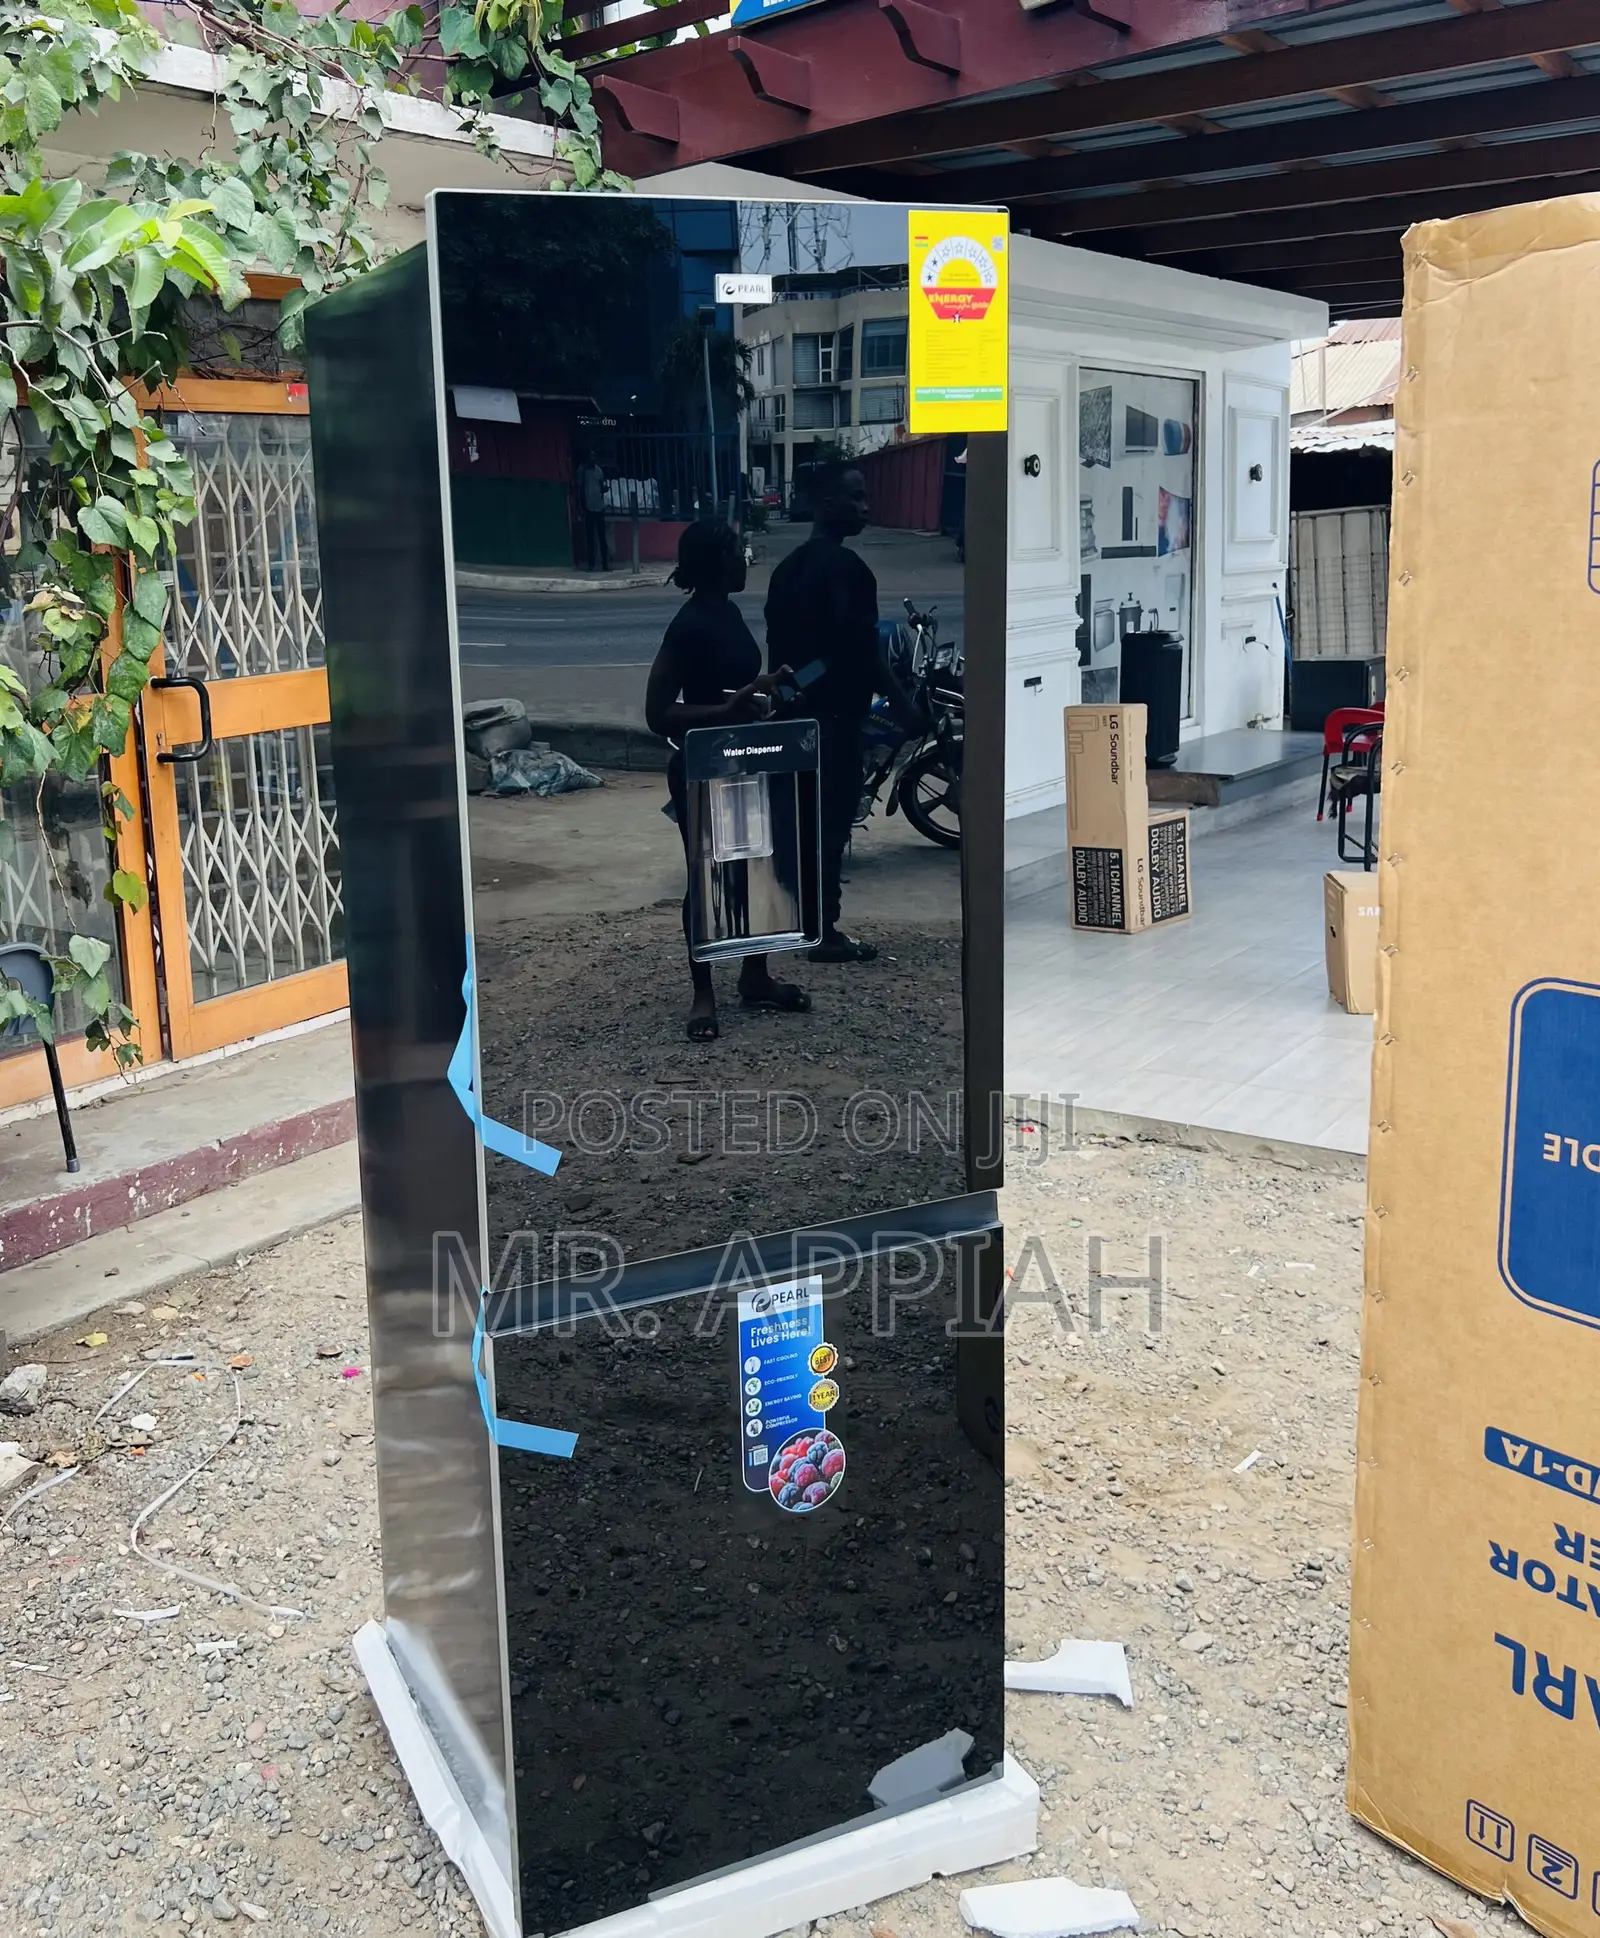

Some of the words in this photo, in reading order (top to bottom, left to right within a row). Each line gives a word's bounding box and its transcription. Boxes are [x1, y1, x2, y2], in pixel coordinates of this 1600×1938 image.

[738, 284, 766, 293] PEARL
[927, 292, 974, 306] ENERGY
[1109, 714, 1119, 730] LG
[723, 748, 745, 757] Water
[746, 745, 783, 755] Dispenser
[1110, 733, 1120, 785] Soundbar
[1151, 828, 1160, 873] DOLBY
[1075, 850, 1087, 886] DOLBY
[1137, 858, 1143, 873] LG
[1077, 888, 1088, 923] AUDIO
[1138, 877, 1146, 928] Soundbar
[1152, 877, 1162, 918] AUDIO
[1543, 1132, 1600, 1173] DLE
[771, 1287, 810, 1306] PEARL
[750, 1317, 808, 1338] Freshness
[751, 1334, 779, 1349] Lives
[781, 1325, 812, 1341] Here!
[763, 1357, 776, 1365] FAST
[764, 1373, 799, 1386] ECO-FRIENDLY
